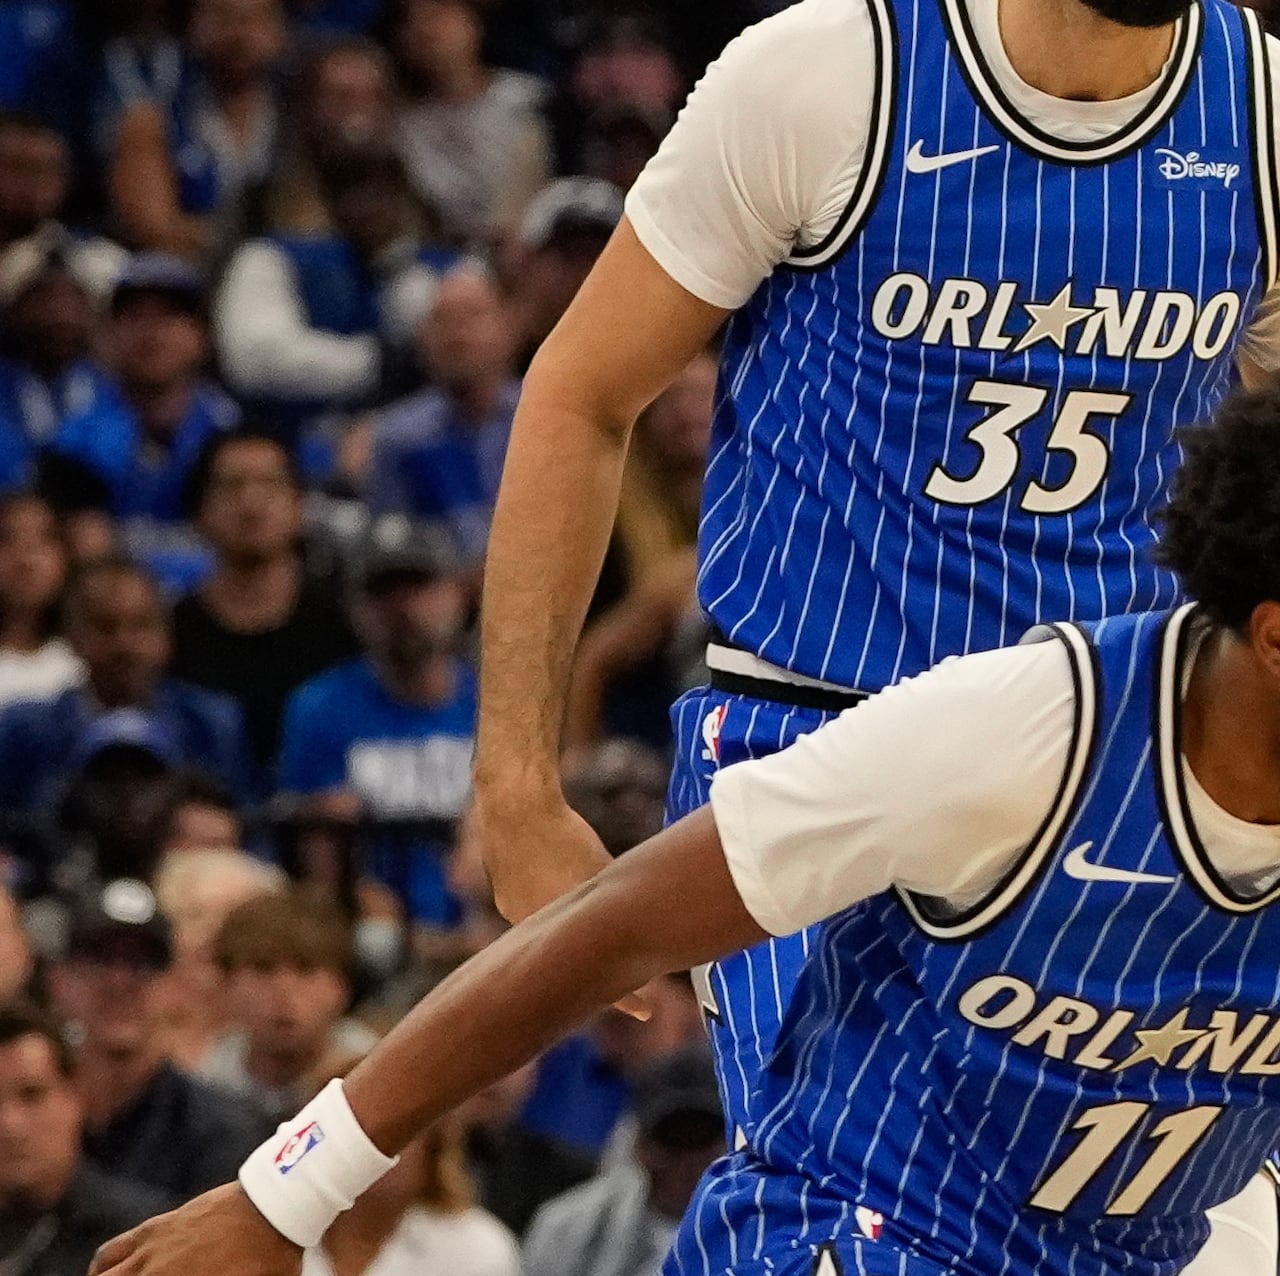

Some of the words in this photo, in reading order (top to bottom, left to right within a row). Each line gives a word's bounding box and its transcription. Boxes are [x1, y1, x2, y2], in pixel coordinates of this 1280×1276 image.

[1154, 148, 1240, 188] Disney
[923, 379, 1133, 514] 35
[1028, 1100, 1224, 1216] 11
